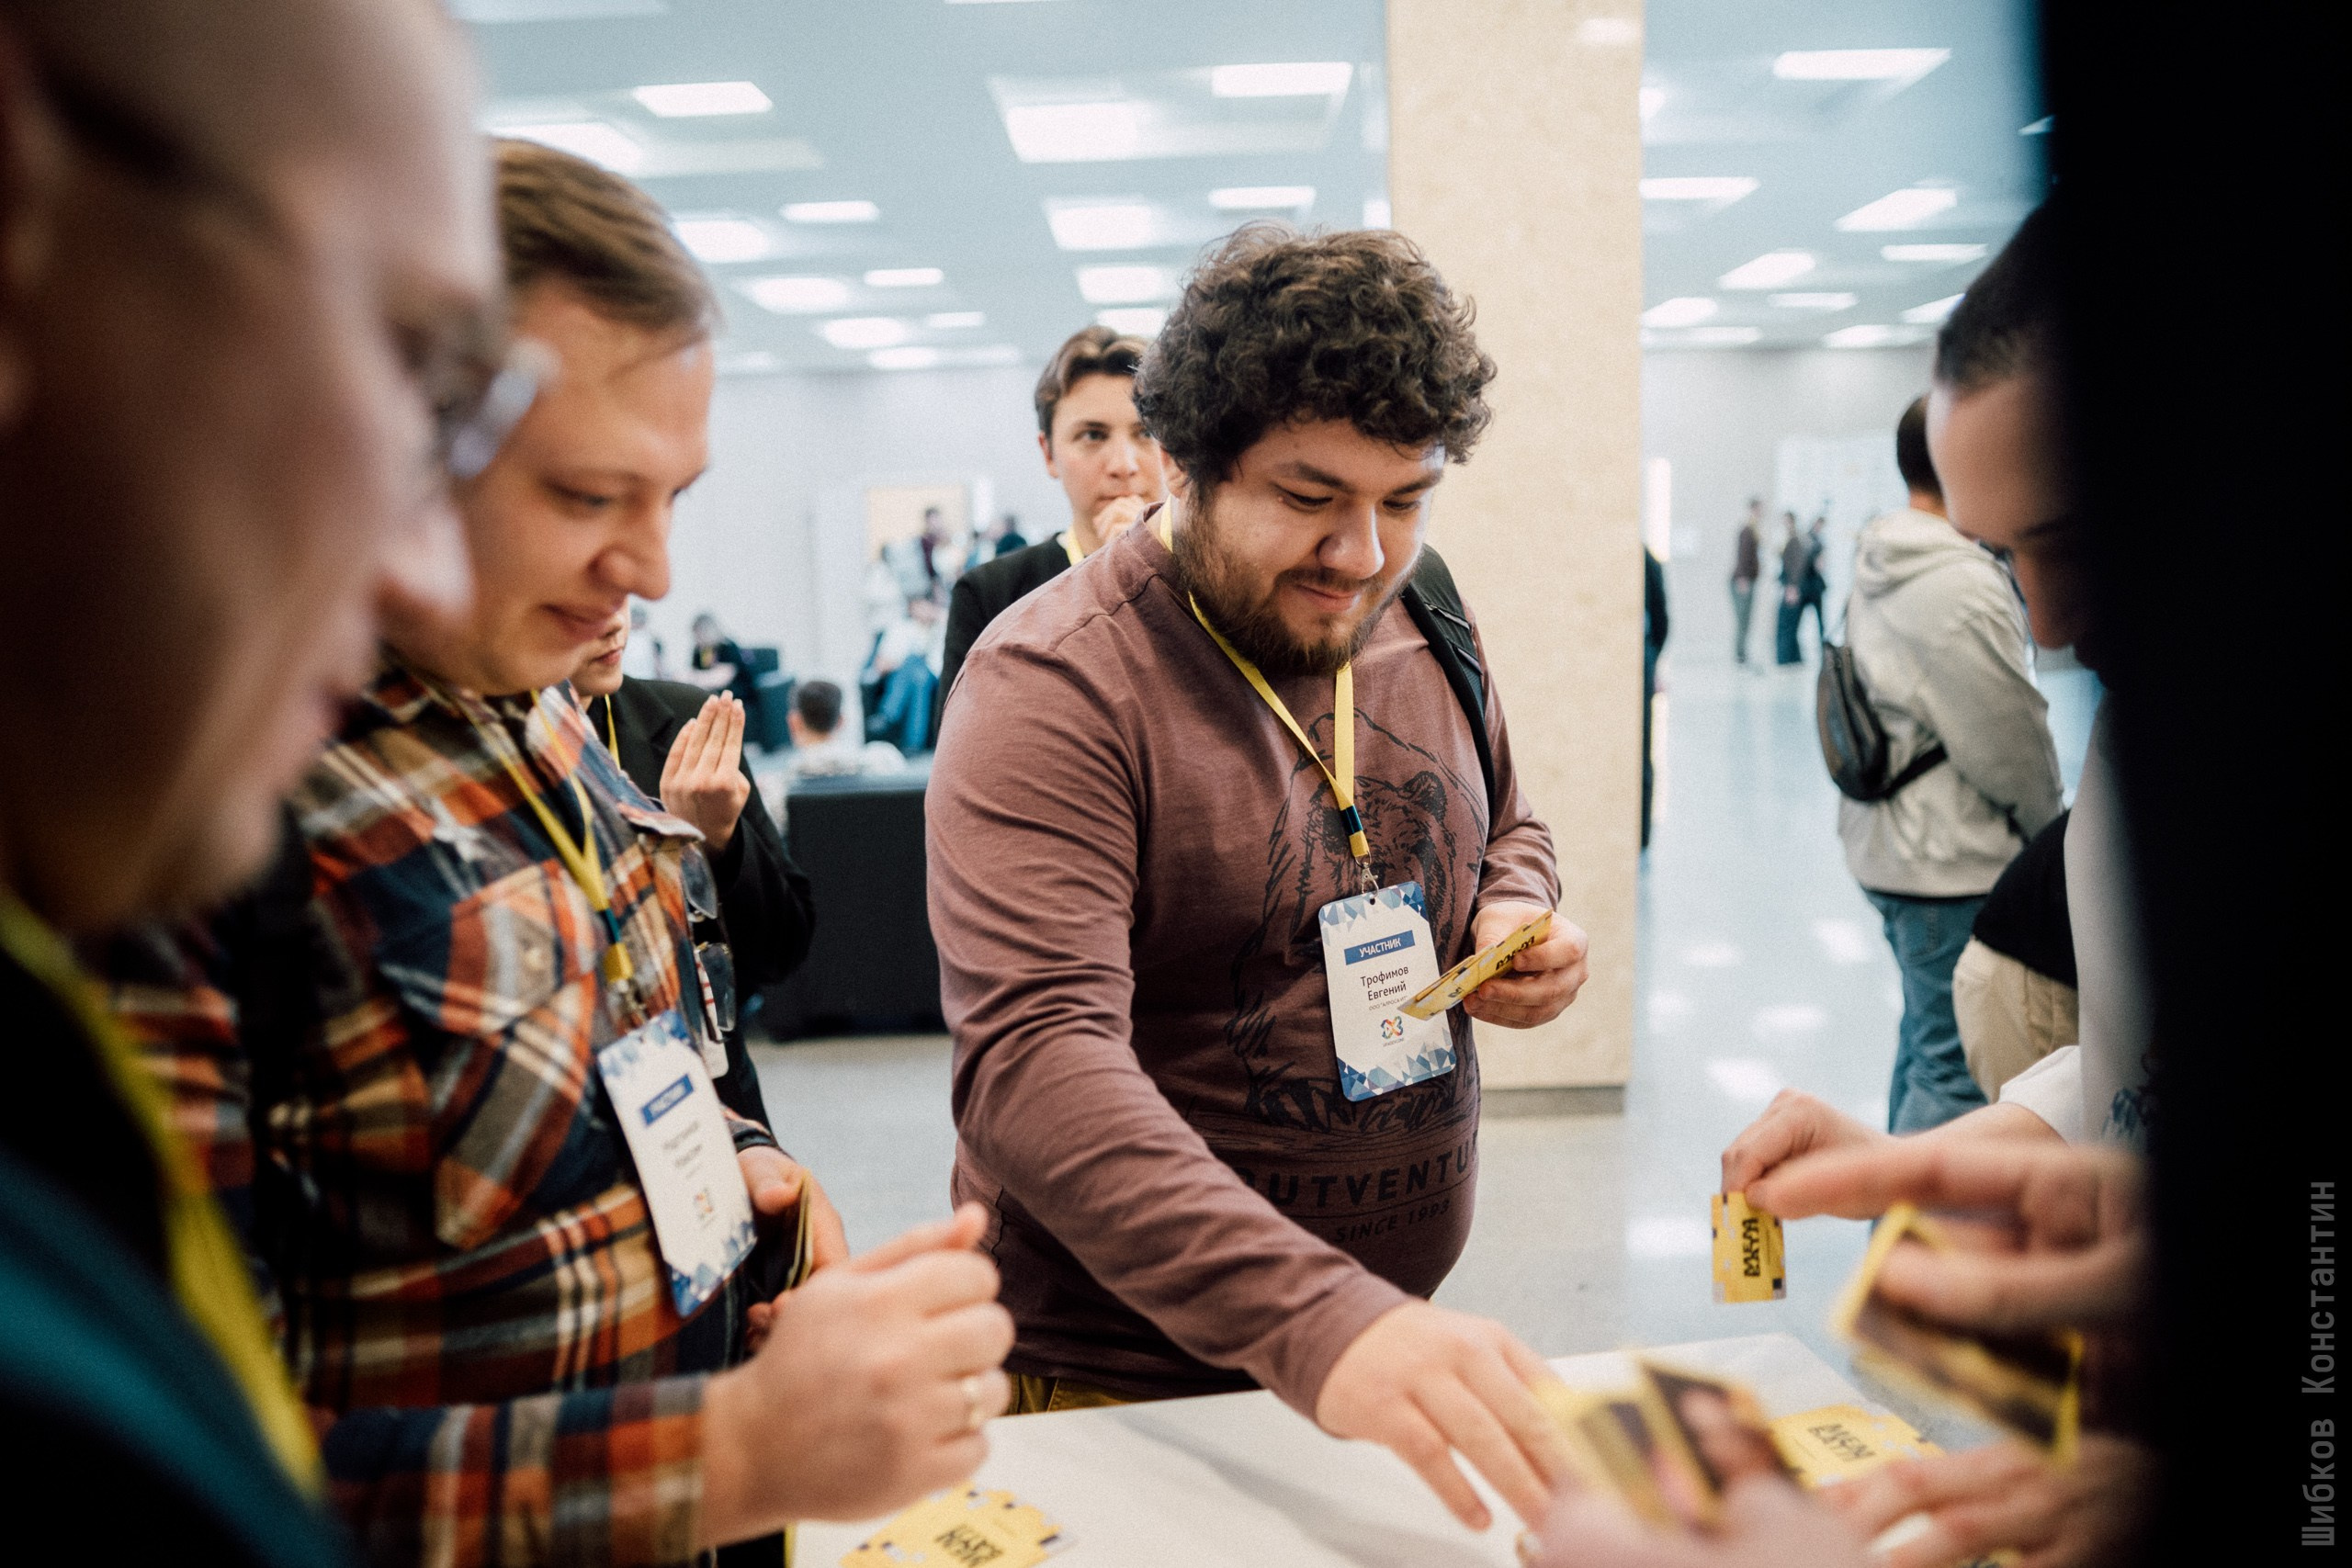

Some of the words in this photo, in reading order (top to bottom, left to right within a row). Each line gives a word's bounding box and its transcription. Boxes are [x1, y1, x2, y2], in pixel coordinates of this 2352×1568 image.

[1359, 937, 1402, 958] УЧАСТНИК
[1360, 966, 1409, 988] Трофимов
[1367, 980, 1407, 1001] Евгений
[1232, 1129, 1478, 1209] UTVENTU
[1336, 1214, 1397, 1242] SINCE
[1408, 1198, 1451, 1226] 1993
